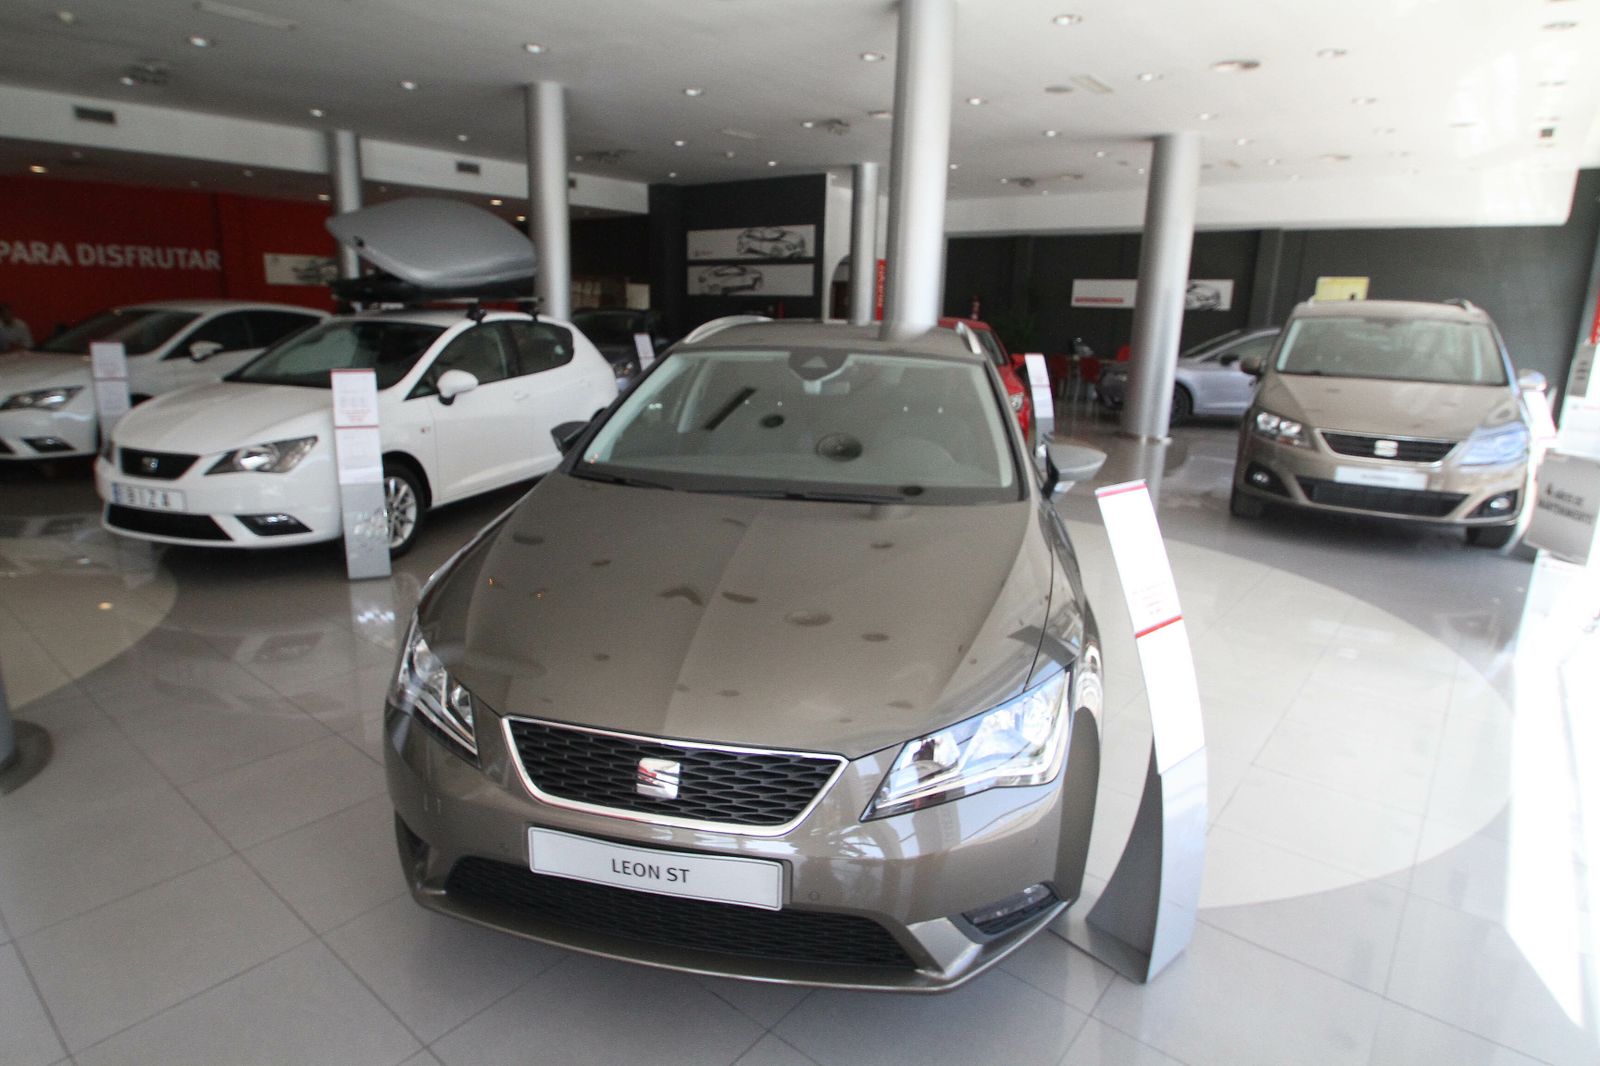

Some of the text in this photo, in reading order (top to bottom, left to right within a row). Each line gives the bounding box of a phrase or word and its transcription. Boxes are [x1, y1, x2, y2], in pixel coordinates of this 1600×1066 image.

[0, 240, 221, 270] PARA DISFRUTAR
[612, 858, 690, 883] LEON ST
